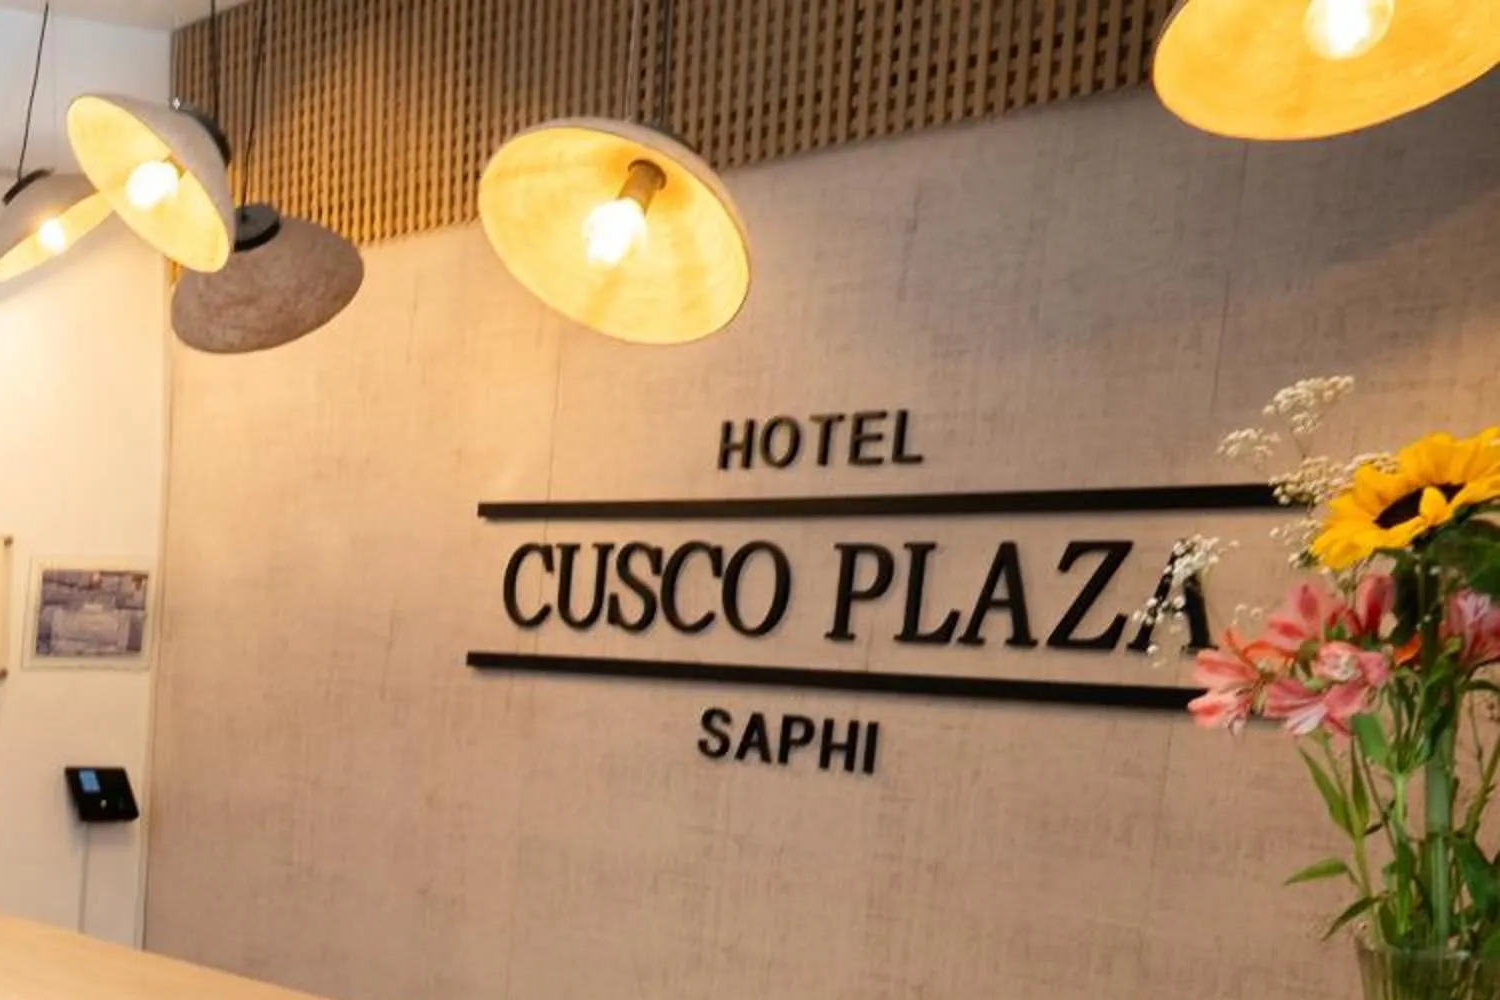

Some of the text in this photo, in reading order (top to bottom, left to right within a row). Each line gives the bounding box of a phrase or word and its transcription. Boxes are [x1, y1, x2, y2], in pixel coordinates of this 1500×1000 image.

[718, 409, 924, 470] HOTEL
[503, 540, 1219, 655] CUSCO PLAZA
[697, 707, 879, 776] SAPHI
